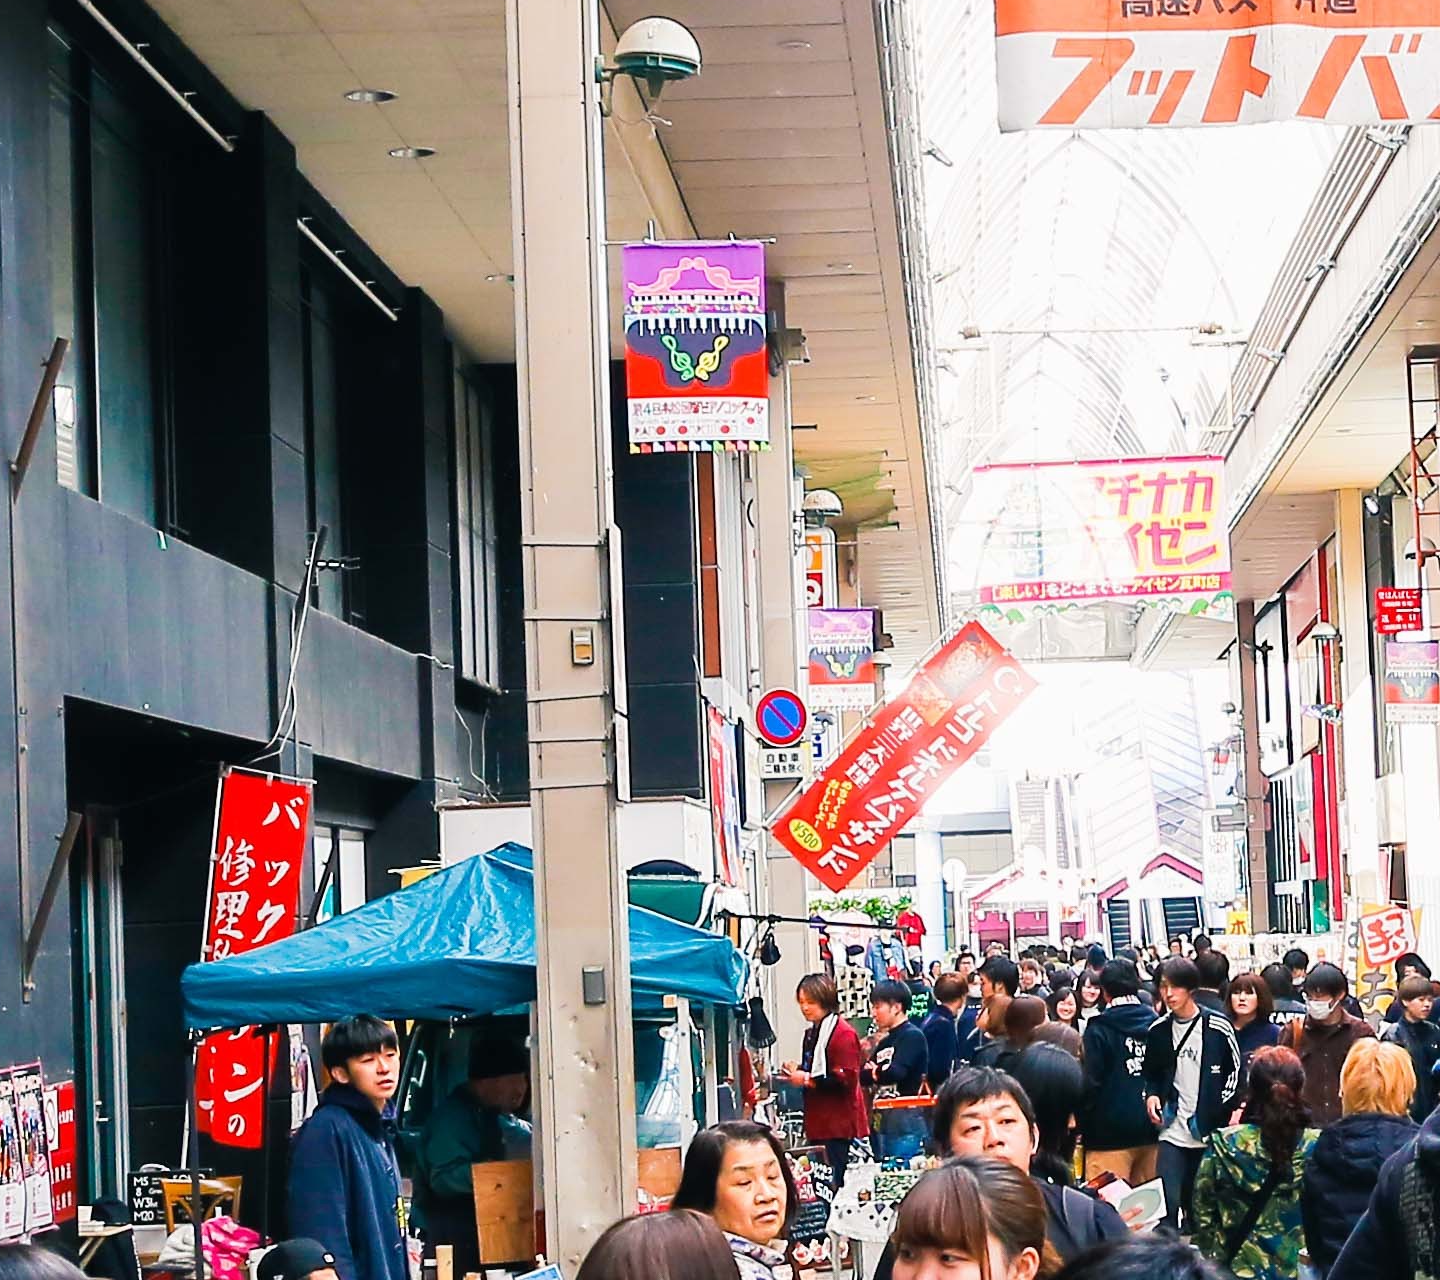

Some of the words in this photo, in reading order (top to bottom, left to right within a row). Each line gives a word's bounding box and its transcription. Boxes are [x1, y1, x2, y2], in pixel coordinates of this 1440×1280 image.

[1095, 471, 1213, 517] チナカ
[766, 753, 799, 763] 自動車
[845, 706, 925, 789] 世界三大料理
[793, 822, 821, 850] ¥500
